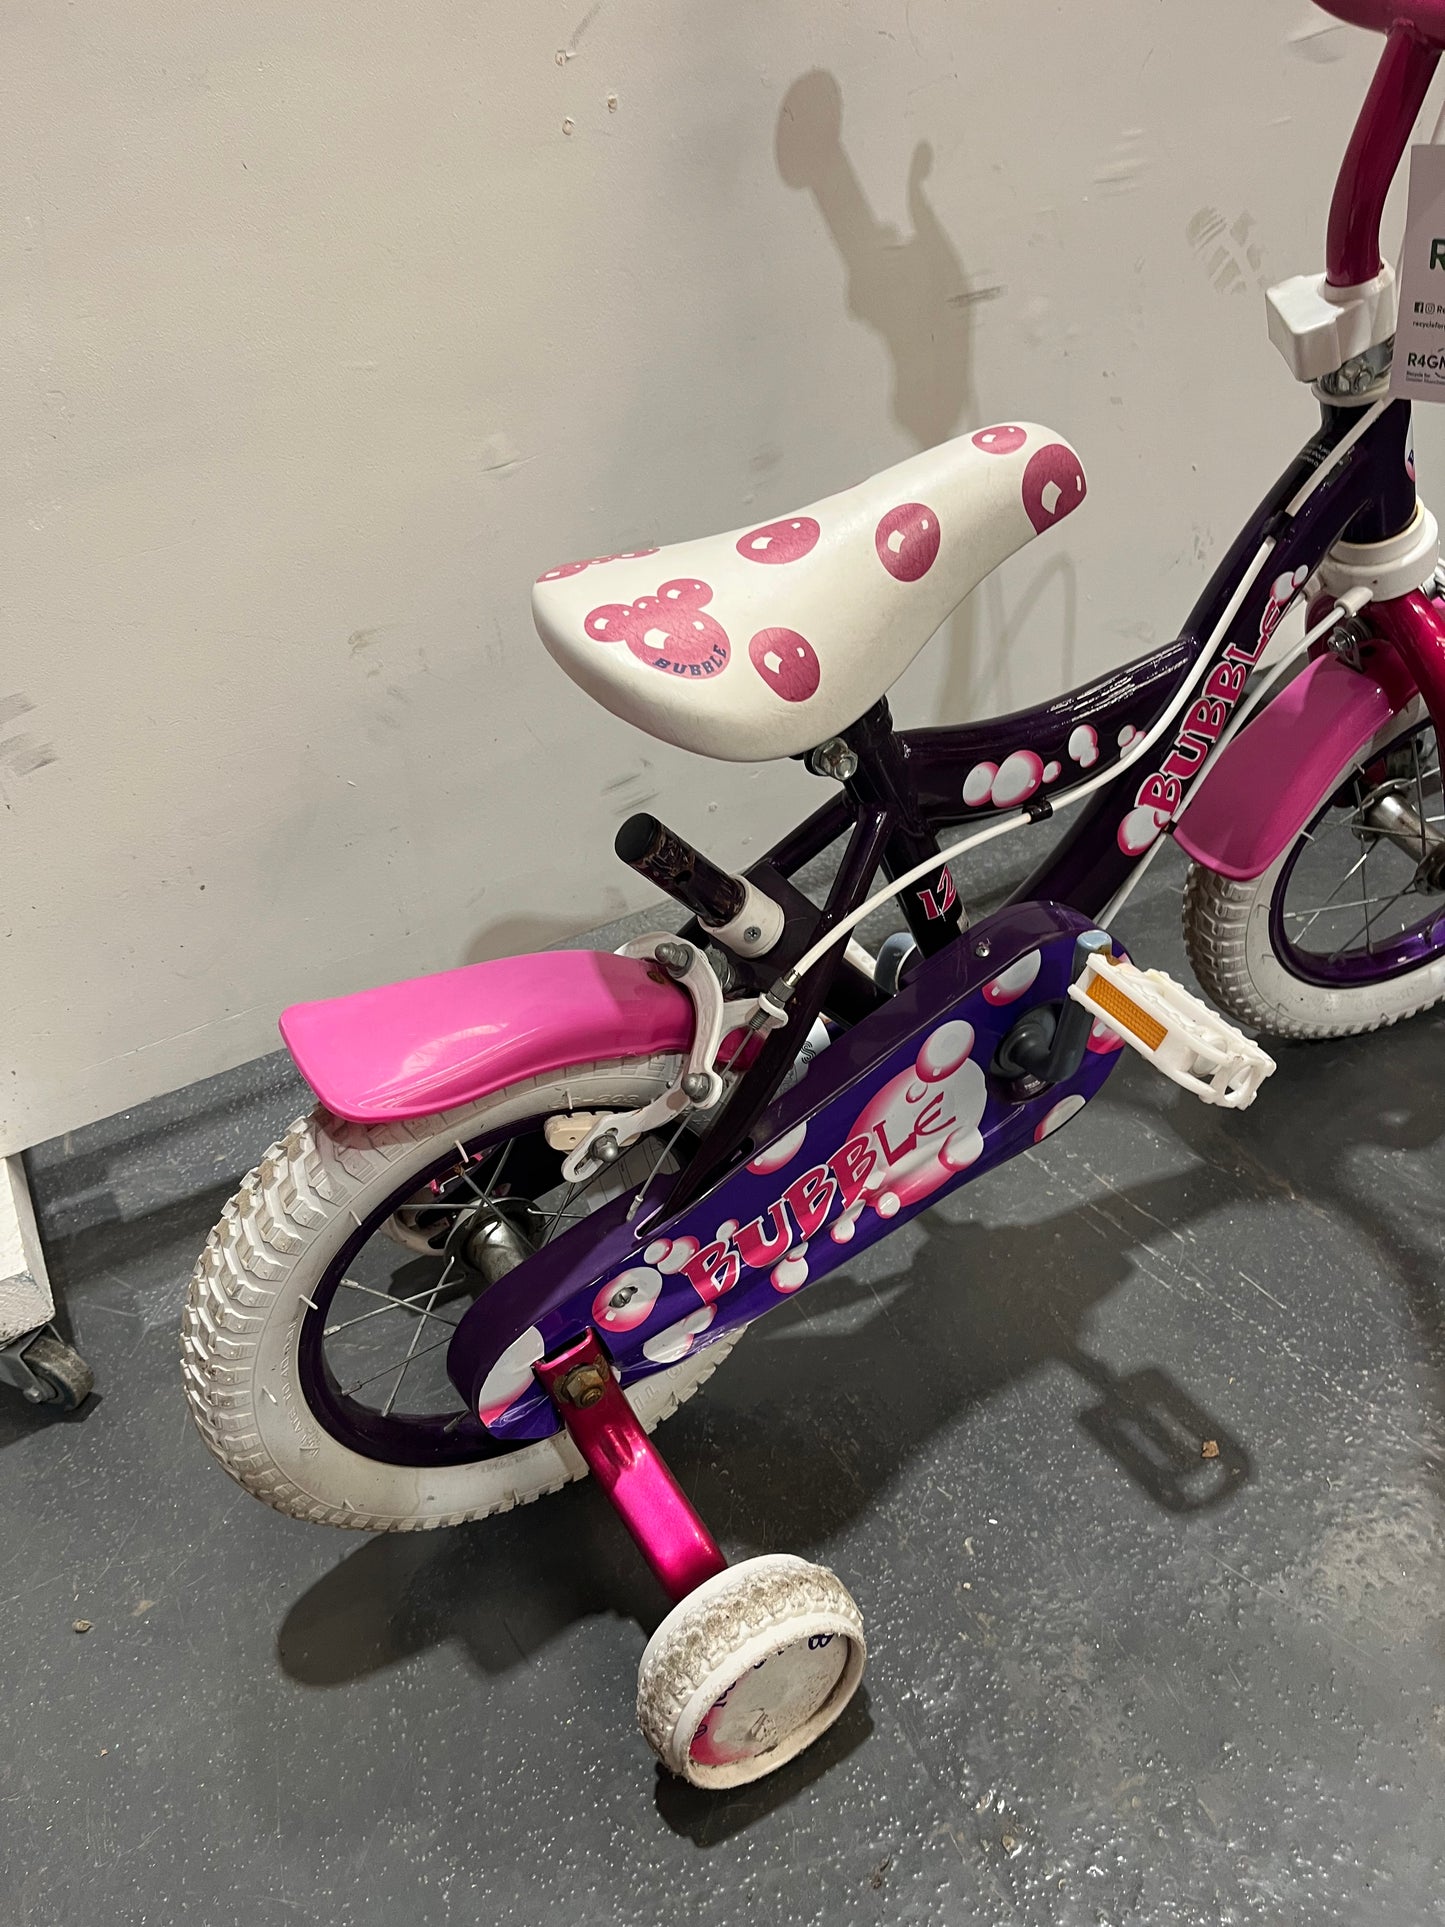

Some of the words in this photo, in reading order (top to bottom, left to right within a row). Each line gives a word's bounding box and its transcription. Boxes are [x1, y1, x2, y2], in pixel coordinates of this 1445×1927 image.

[1412, 320, 1445, 331] recyclefor
[652, 643, 727, 676] BUBBLE
[1134, 596, 1284, 816] BUBBLE
[916, 863, 957, 920] 12
[679, 1091, 957, 1306] BUBBLE
